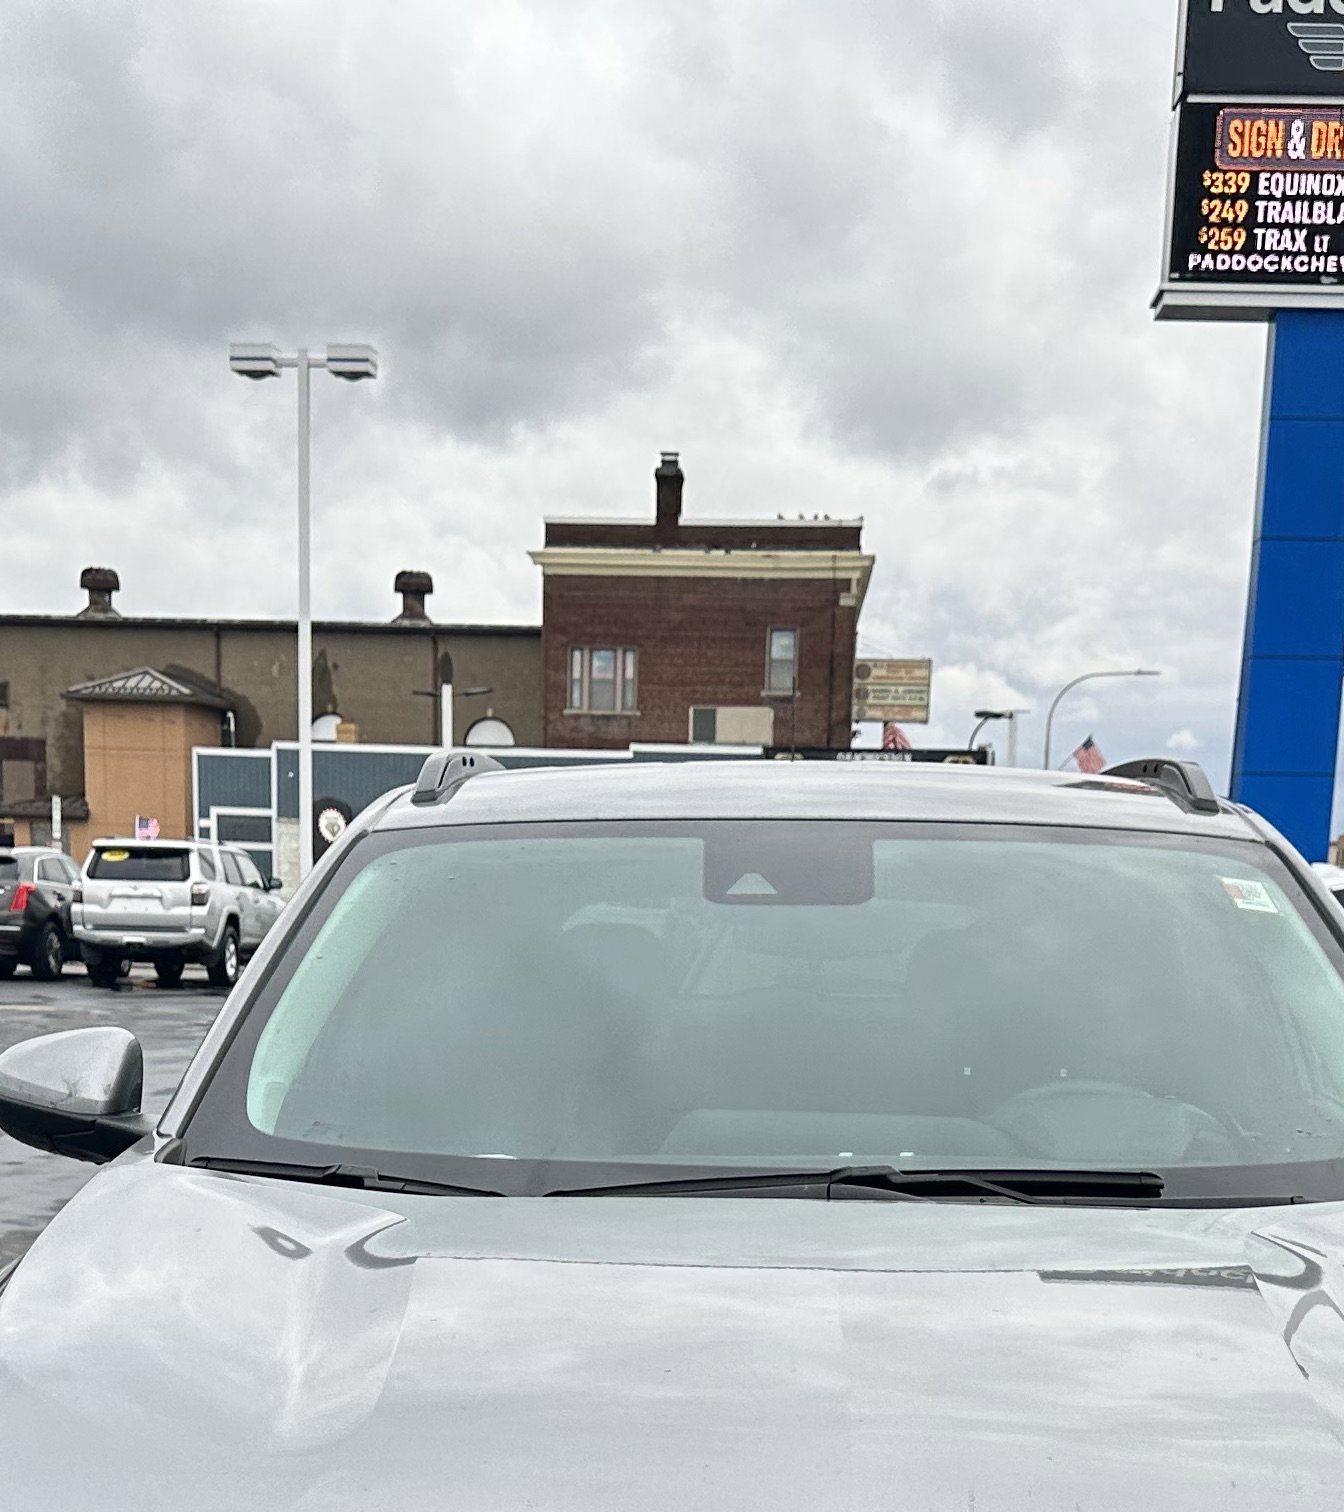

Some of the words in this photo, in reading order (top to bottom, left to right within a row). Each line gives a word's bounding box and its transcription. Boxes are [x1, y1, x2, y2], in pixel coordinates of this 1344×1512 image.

[1228, 119, 1285, 158] SIGN
[1287, 118, 1307, 159] &
[1202, 169, 1250, 194] $339
[1200, 198, 1249, 223] $249
[1198, 226, 1247, 251] $259
[1253, 228, 1308, 252] TRAX
[1313, 234, 1330, 252] LT
